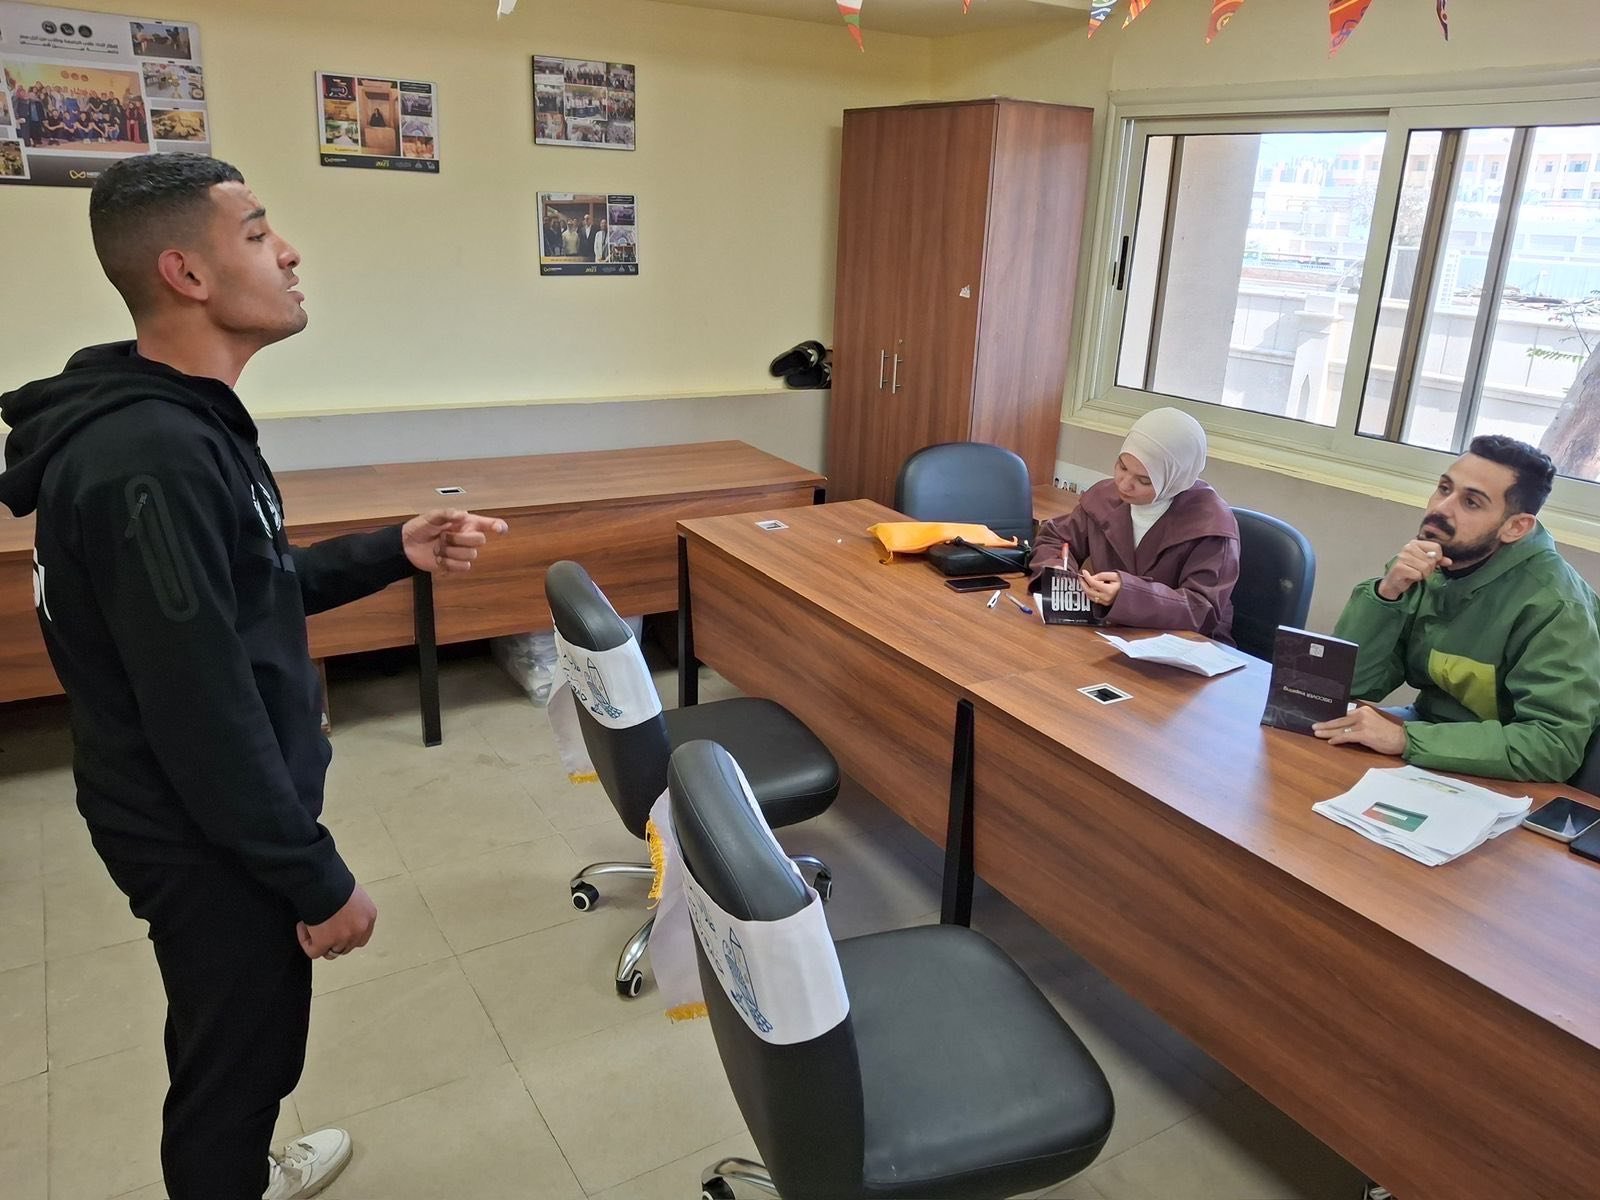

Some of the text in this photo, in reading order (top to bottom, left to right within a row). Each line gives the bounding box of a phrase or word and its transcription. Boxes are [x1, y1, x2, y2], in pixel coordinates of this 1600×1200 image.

[1051, 576, 1084, 591] ORUM
[1051, 591, 1091, 611] MEDIA
[1306, 693, 1332, 704] DISCOVER
